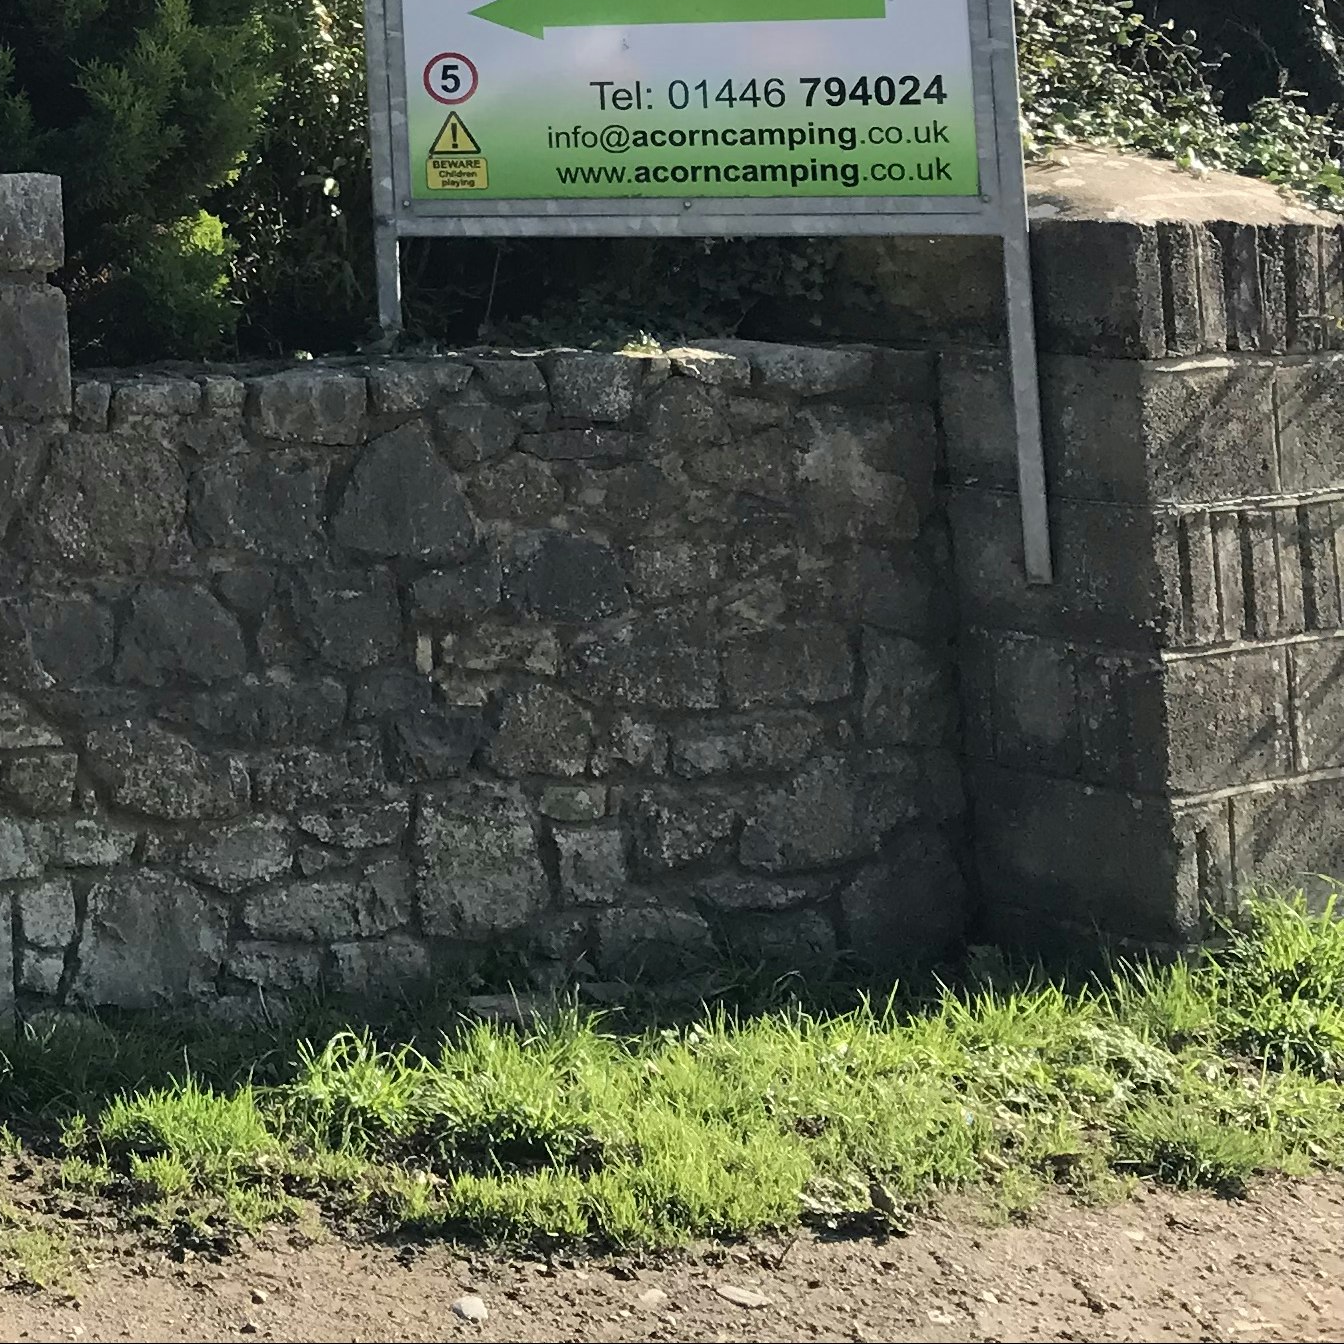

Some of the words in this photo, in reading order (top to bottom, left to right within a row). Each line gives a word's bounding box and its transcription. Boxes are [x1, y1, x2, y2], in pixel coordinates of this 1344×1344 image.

[441, 64, 461, 93] 5
[589, 81, 653, 111] Tel:
[668, 77, 787, 109] 01446
[799, 75, 948, 107] 794024
[547, 120, 950, 154] info@acorncamping.co.uk
[432, 159, 481, 169] BEWARE
[438, 169, 478, 178] Children
[556, 157, 953, 187] www.acorncamping.co.uk
[441, 177, 476, 188] playing
